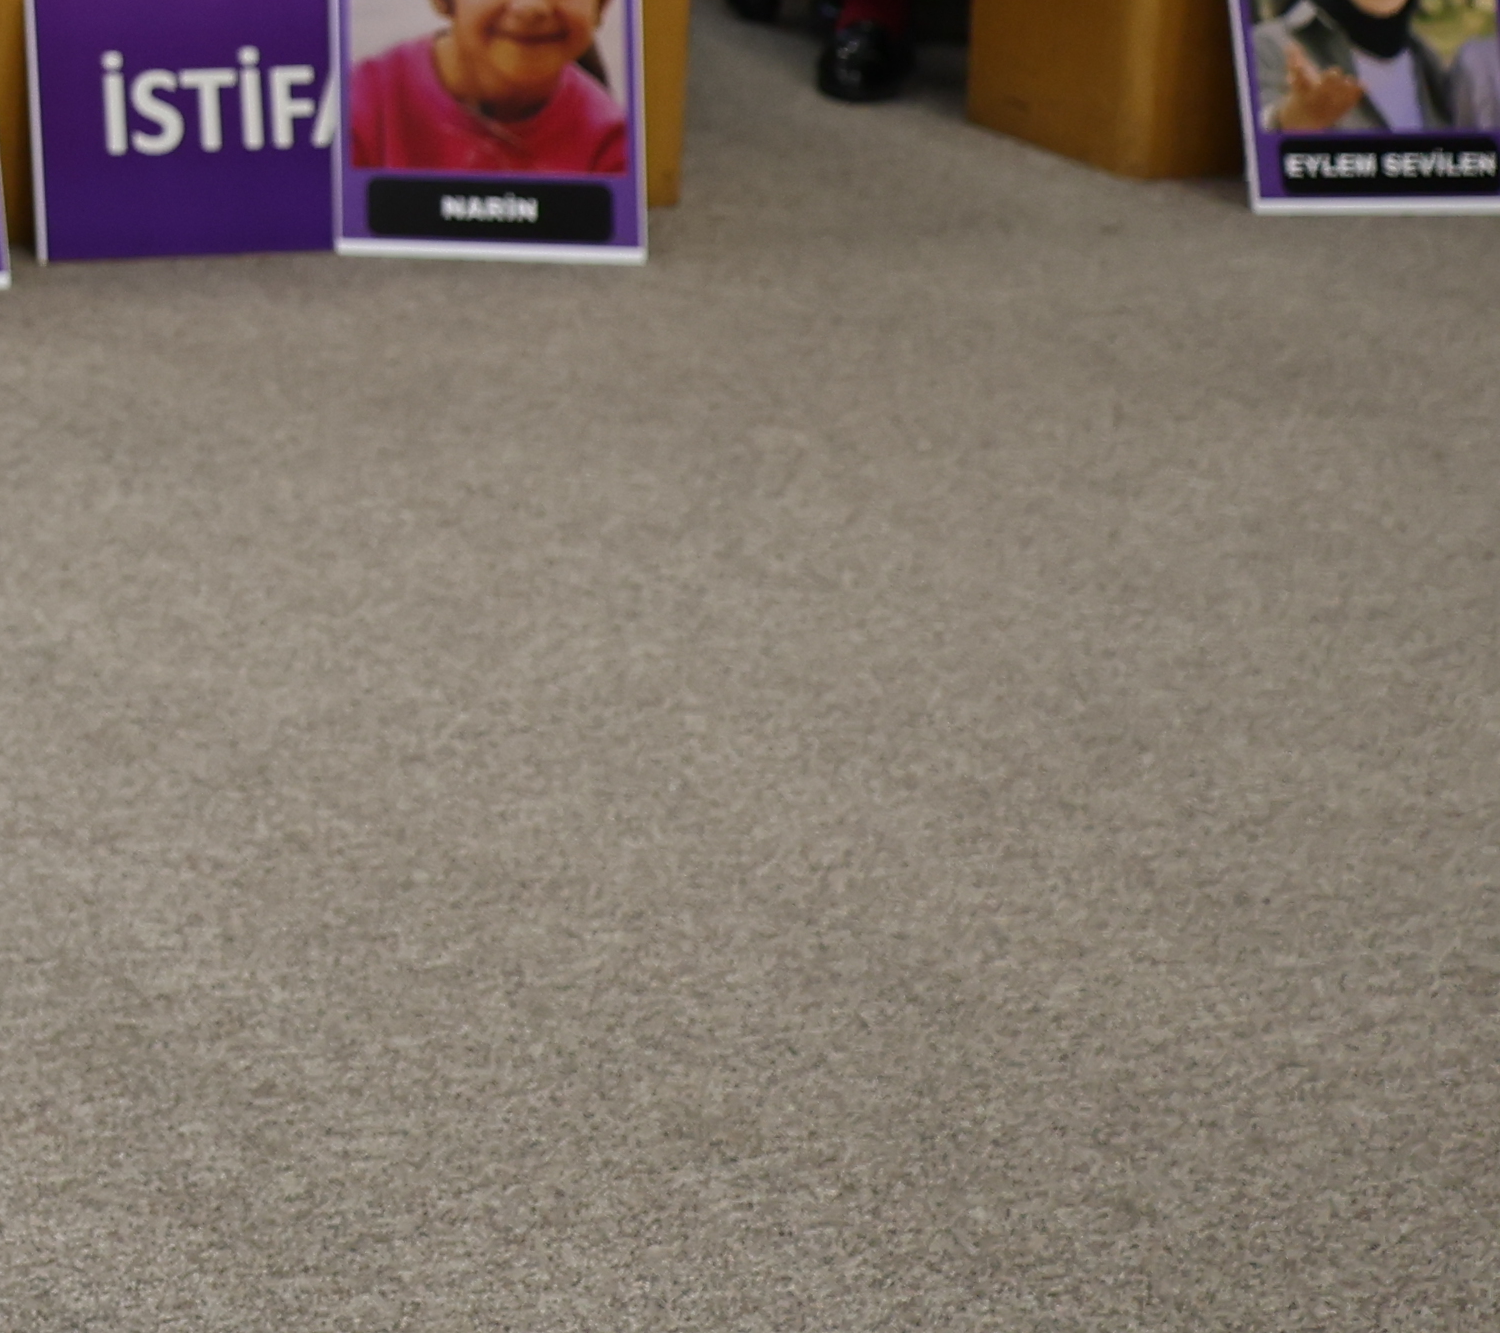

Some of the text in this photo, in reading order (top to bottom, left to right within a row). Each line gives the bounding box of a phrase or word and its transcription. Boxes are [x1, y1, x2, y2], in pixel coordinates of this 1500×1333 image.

[1284, 147, 1498, 179] EYLEM SEVİLEN
[440, 193, 539, 222] NARİN
